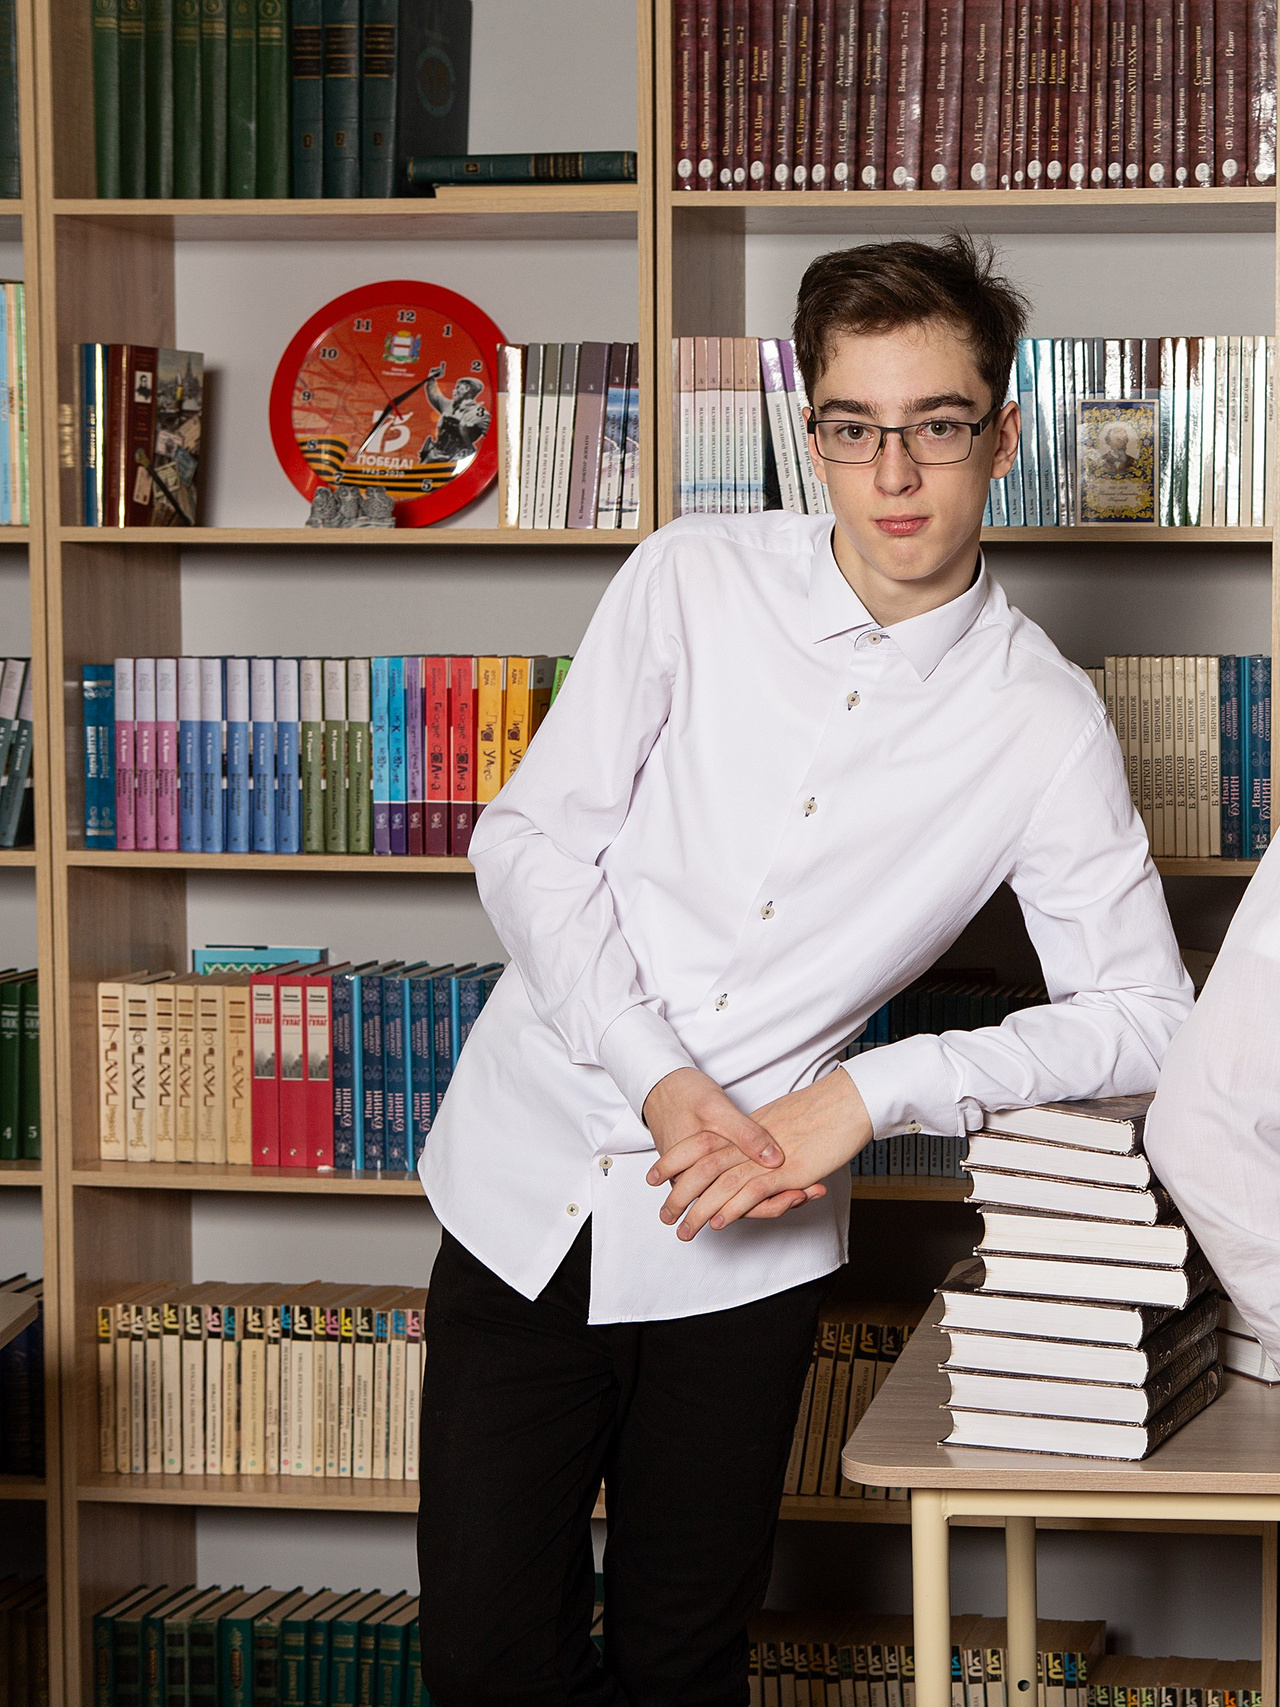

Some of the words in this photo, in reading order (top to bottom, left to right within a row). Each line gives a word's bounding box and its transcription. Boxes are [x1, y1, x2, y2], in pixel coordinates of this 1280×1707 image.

[780, 15, 788, 47] Повести
[1019, 7, 1027, 39] Юность
[978, 23, 986, 61] Каренина
[1194, 26, 1203, 85] Стихотворения
[1226, 31, 1235, 56] Идиот
[760, 50, 768, 81] Повести
[1018, 43, 1027, 89] Отрочество
[1059, 49, 1067, 84] Рассказы
[1154, 45, 1162, 80] Поднятая
[1203, 57, 1212, 84] Поэмы
[898, 68, 907, 92] Война
[1129, 94, 1137, 117] басня
[1226, 70, 1235, 122] Достоевский
[755, 95, 763, 128] Шукшин
[778, 106, 786, 130] Чехов
[897, 100, 906, 132] Толстой
[975, 97, 984, 129] Толстой
[1016, 95, 1025, 128] Толстой
[1052, 98, 1060, 132] Распутин
[1154, 95, 1162, 129] Шолохов
[1199, 93, 1207, 132] Некрасов
[1128, 118, 1137, 149] Русская
[354, 319, 371, 331] 11
[398, 310, 416, 322] 12
[444, 325, 452, 336] 1
[321, 348, 337, 359] 10
[472, 360, 482, 372] 2
[302, 391, 312, 401] 9
[476, 407, 485, 417] 3
[306, 439, 318, 450] 8
[333, 471, 344, 483] 7
[356, 455, 413, 470] ПОБЕДА!
[422, 479, 432, 491] 5
[365, 1090, 373, 1118] Иван
